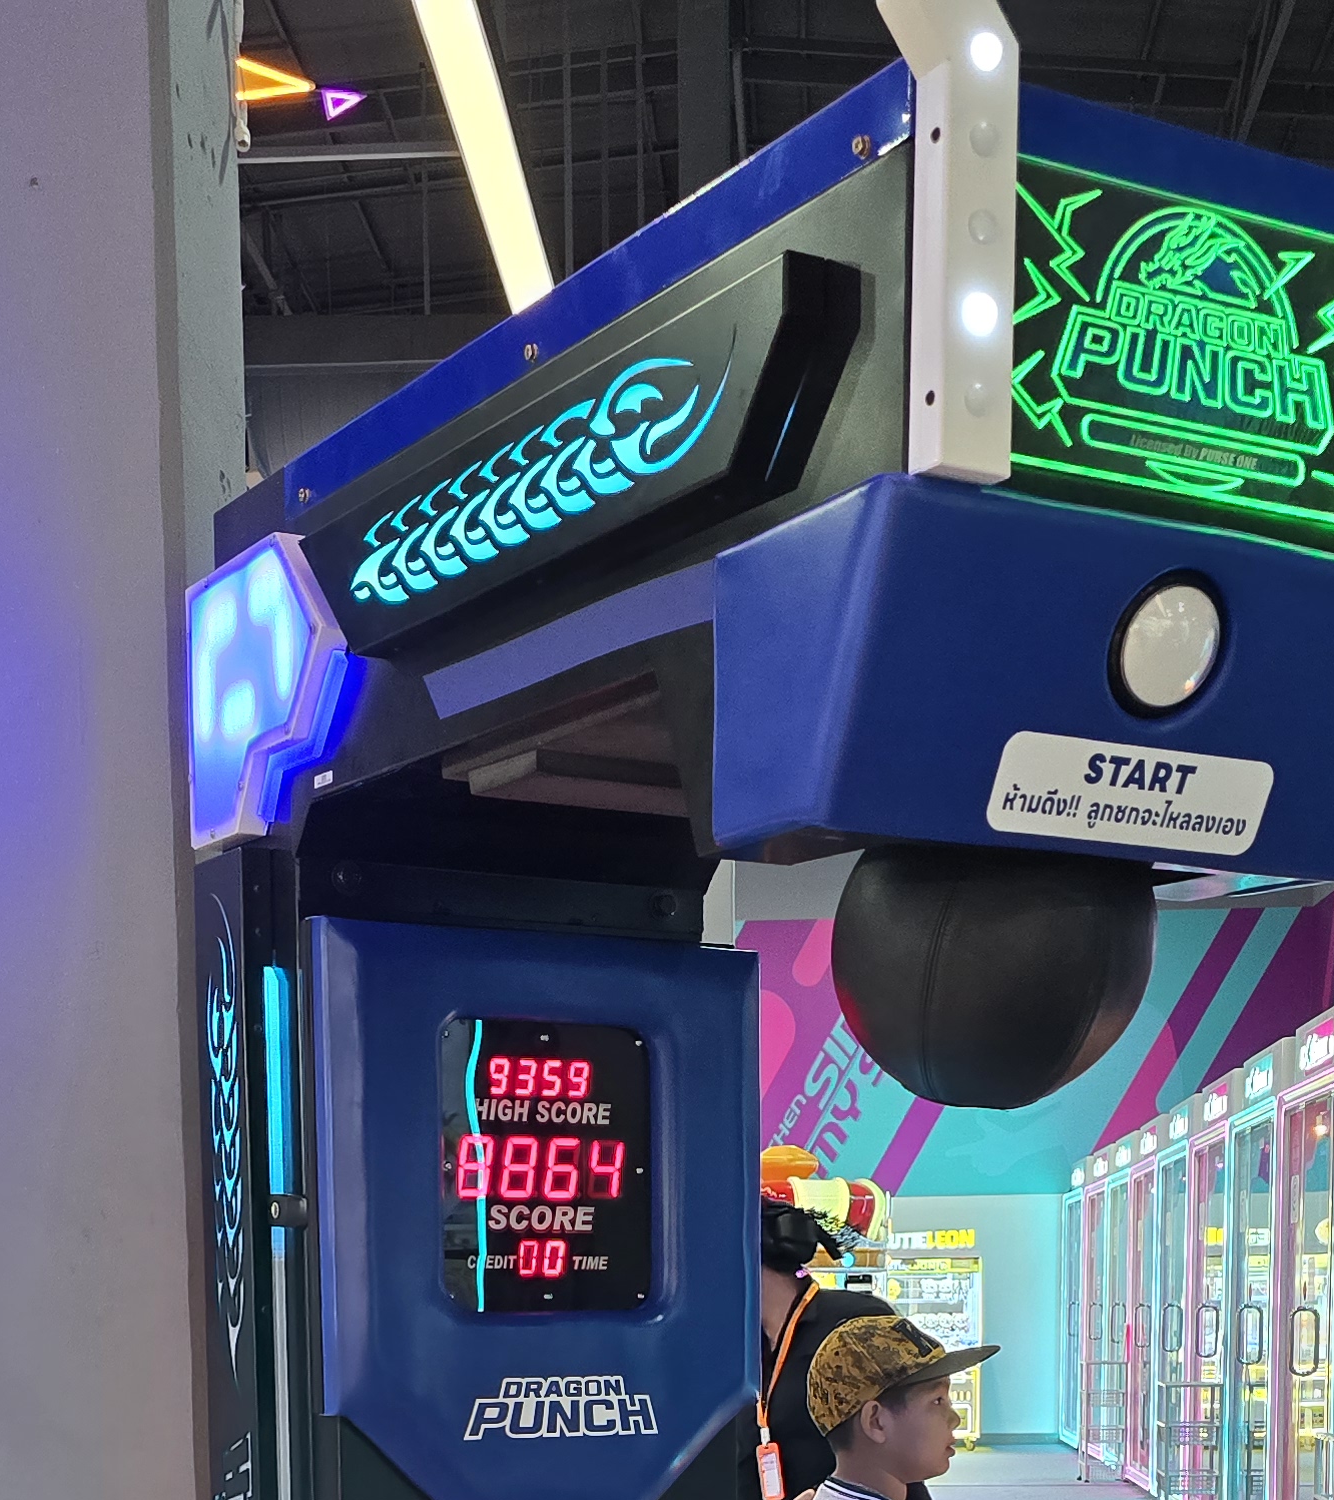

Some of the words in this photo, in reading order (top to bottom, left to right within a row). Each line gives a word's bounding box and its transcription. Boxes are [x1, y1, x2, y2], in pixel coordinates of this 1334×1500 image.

[1110, 288, 1285, 354] DRAGON
[1061, 316, 1327, 430] PUNCH
[1236, 456, 1258, 471] ONE
[1084, 753, 1198, 796] START
[1002, 783, 1082, 819] ห้ามดึง!!
[1087, 800, 1247, 838] ลูกชกจะไหลลงเอง
[489, 1055, 593, 1098] 9359
[475, 1098, 529, 1123] HIGH
[535, 1101, 611, 1126] SCORE
[456, 1133, 626, 1200] 8864
[489, 1204, 595, 1231] SCORE
[517, 1238, 565, 1278] 00
[572, 1255, 608, 1271] TIME
[887, 1229, 976, 1250] UTIELEON
[502, 1376, 626, 1400] DRAGON
[464, 1394, 658, 1440] PUNCH
